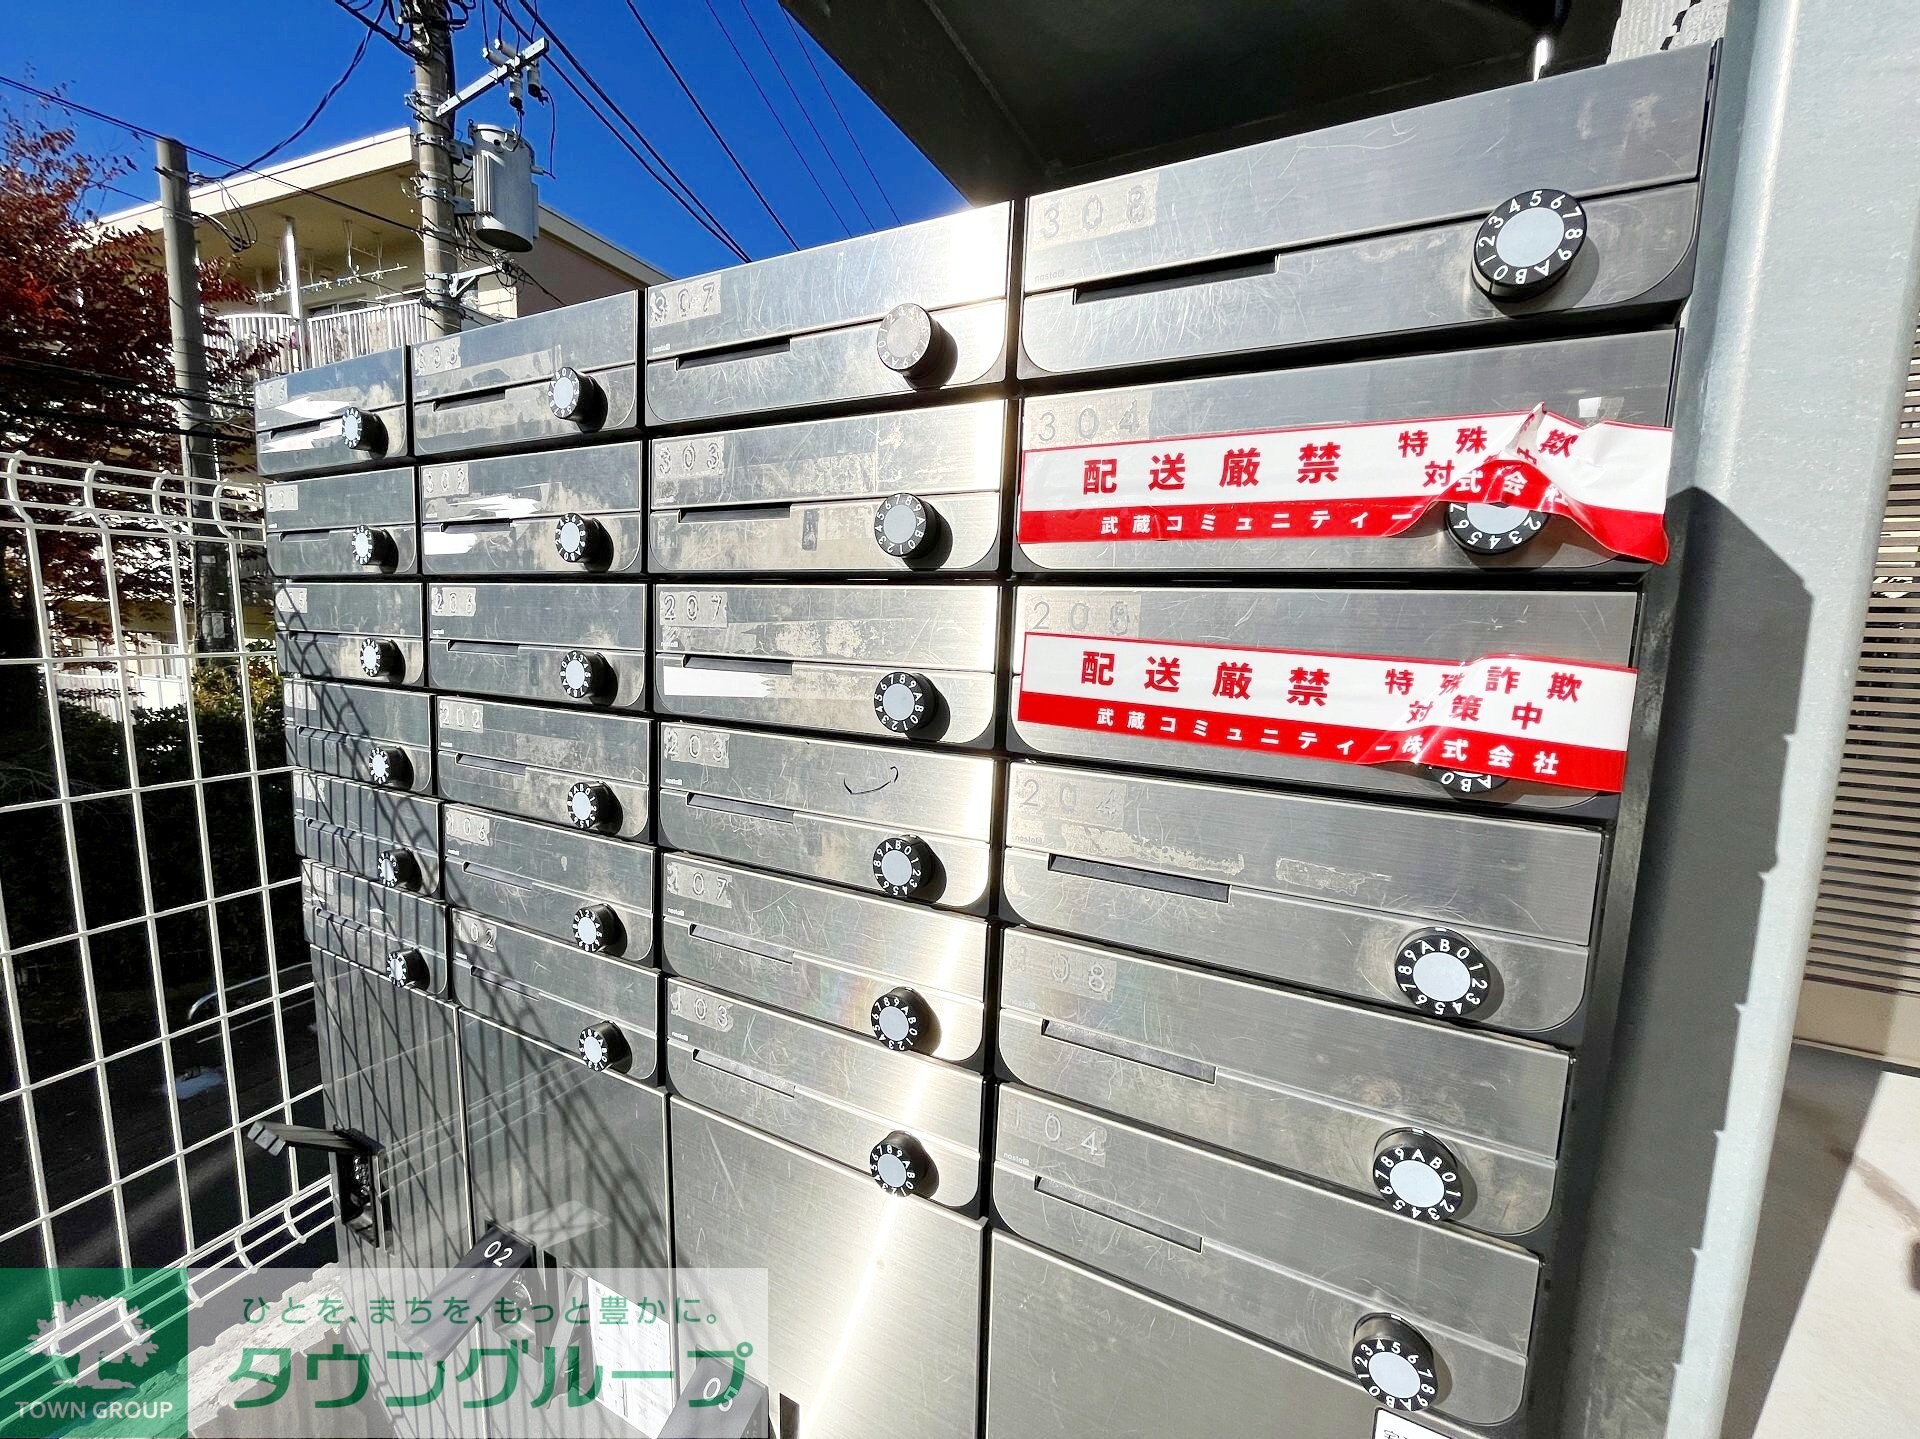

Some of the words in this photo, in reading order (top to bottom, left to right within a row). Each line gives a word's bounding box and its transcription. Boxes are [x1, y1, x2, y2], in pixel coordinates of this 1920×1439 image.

[1038, 399, 1141, 442] 304
[1083, 443, 1341, 494] 配送厳禁
[1081, 652, 1330, 706] 配送厳禁
[1385, 666, 1582, 703] 特殊詐欺
[484, 1241, 513, 1267] 02
